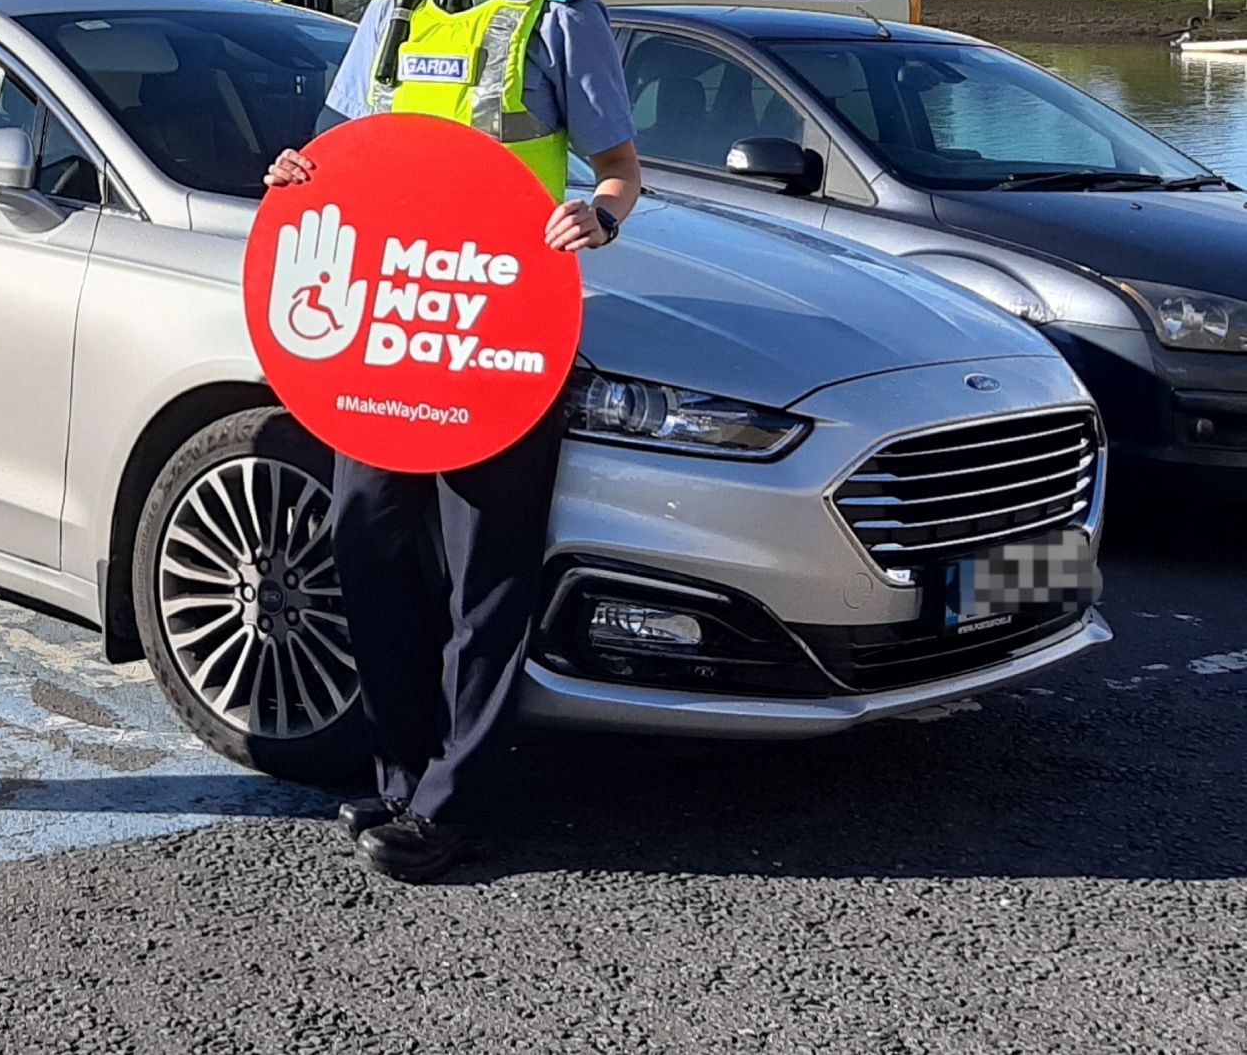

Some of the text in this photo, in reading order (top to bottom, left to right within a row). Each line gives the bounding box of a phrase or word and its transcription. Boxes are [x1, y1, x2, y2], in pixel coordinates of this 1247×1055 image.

[404, 57, 461, 76] GARDA
[380, 237, 520, 286] Make
[372, 280, 488, 330] Way
[363, 322, 545, 374] Day.com
[335, 395, 470, 425] #MakeWayDay20
